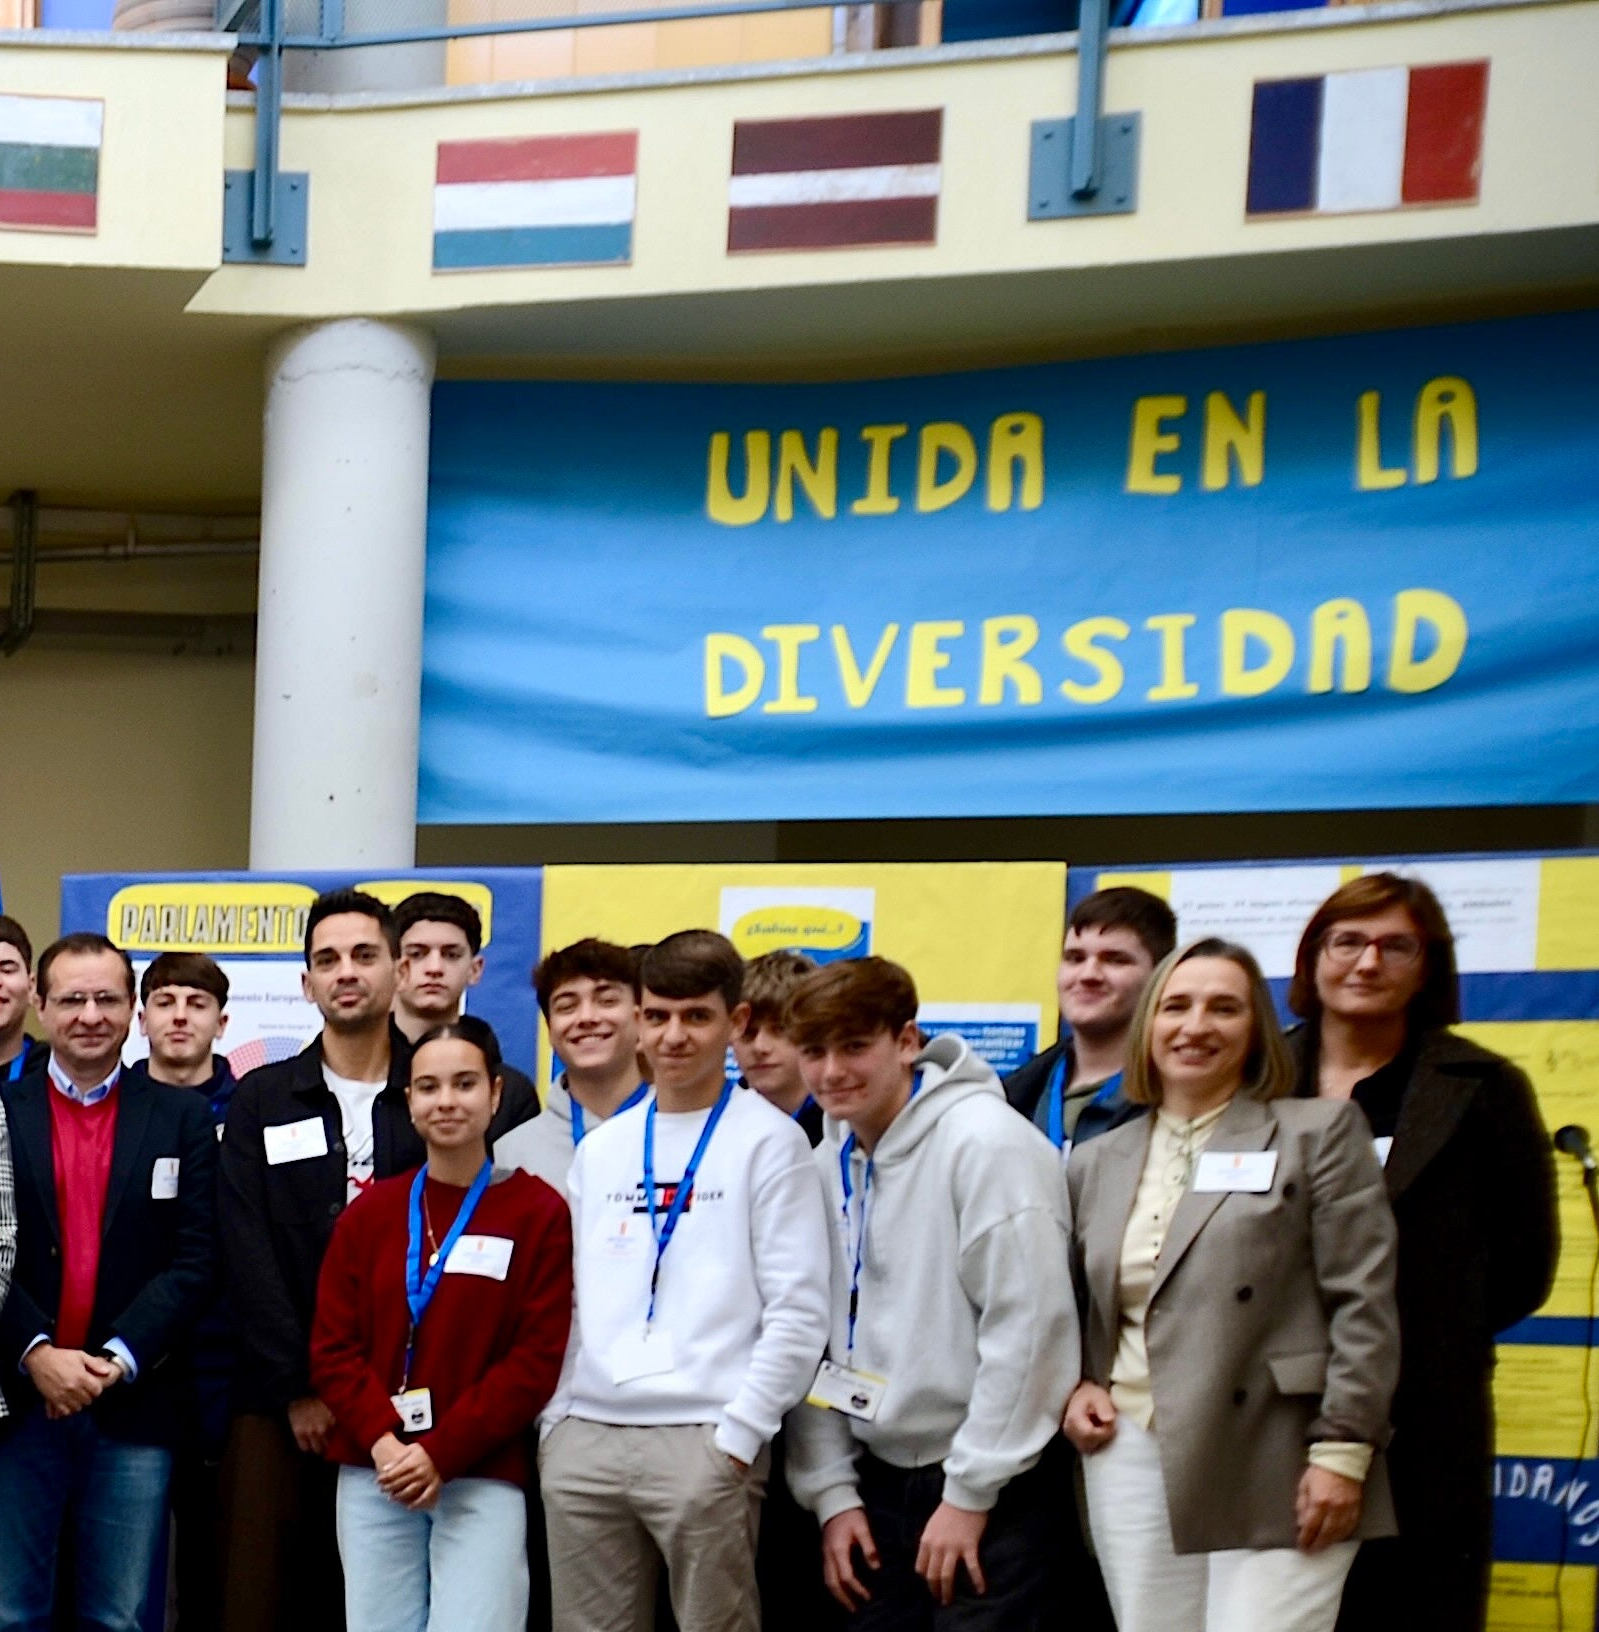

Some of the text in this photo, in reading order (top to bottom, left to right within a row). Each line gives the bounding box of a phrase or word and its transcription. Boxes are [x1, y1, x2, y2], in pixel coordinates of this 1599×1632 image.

[706, 376, 1481, 526] UNIDA EN LA
[704, 589, 1470, 718] DIVERSIDAD
[120, 902, 310, 945] PARLAMENTO
[606, 1192, 646, 1203] TOMM
